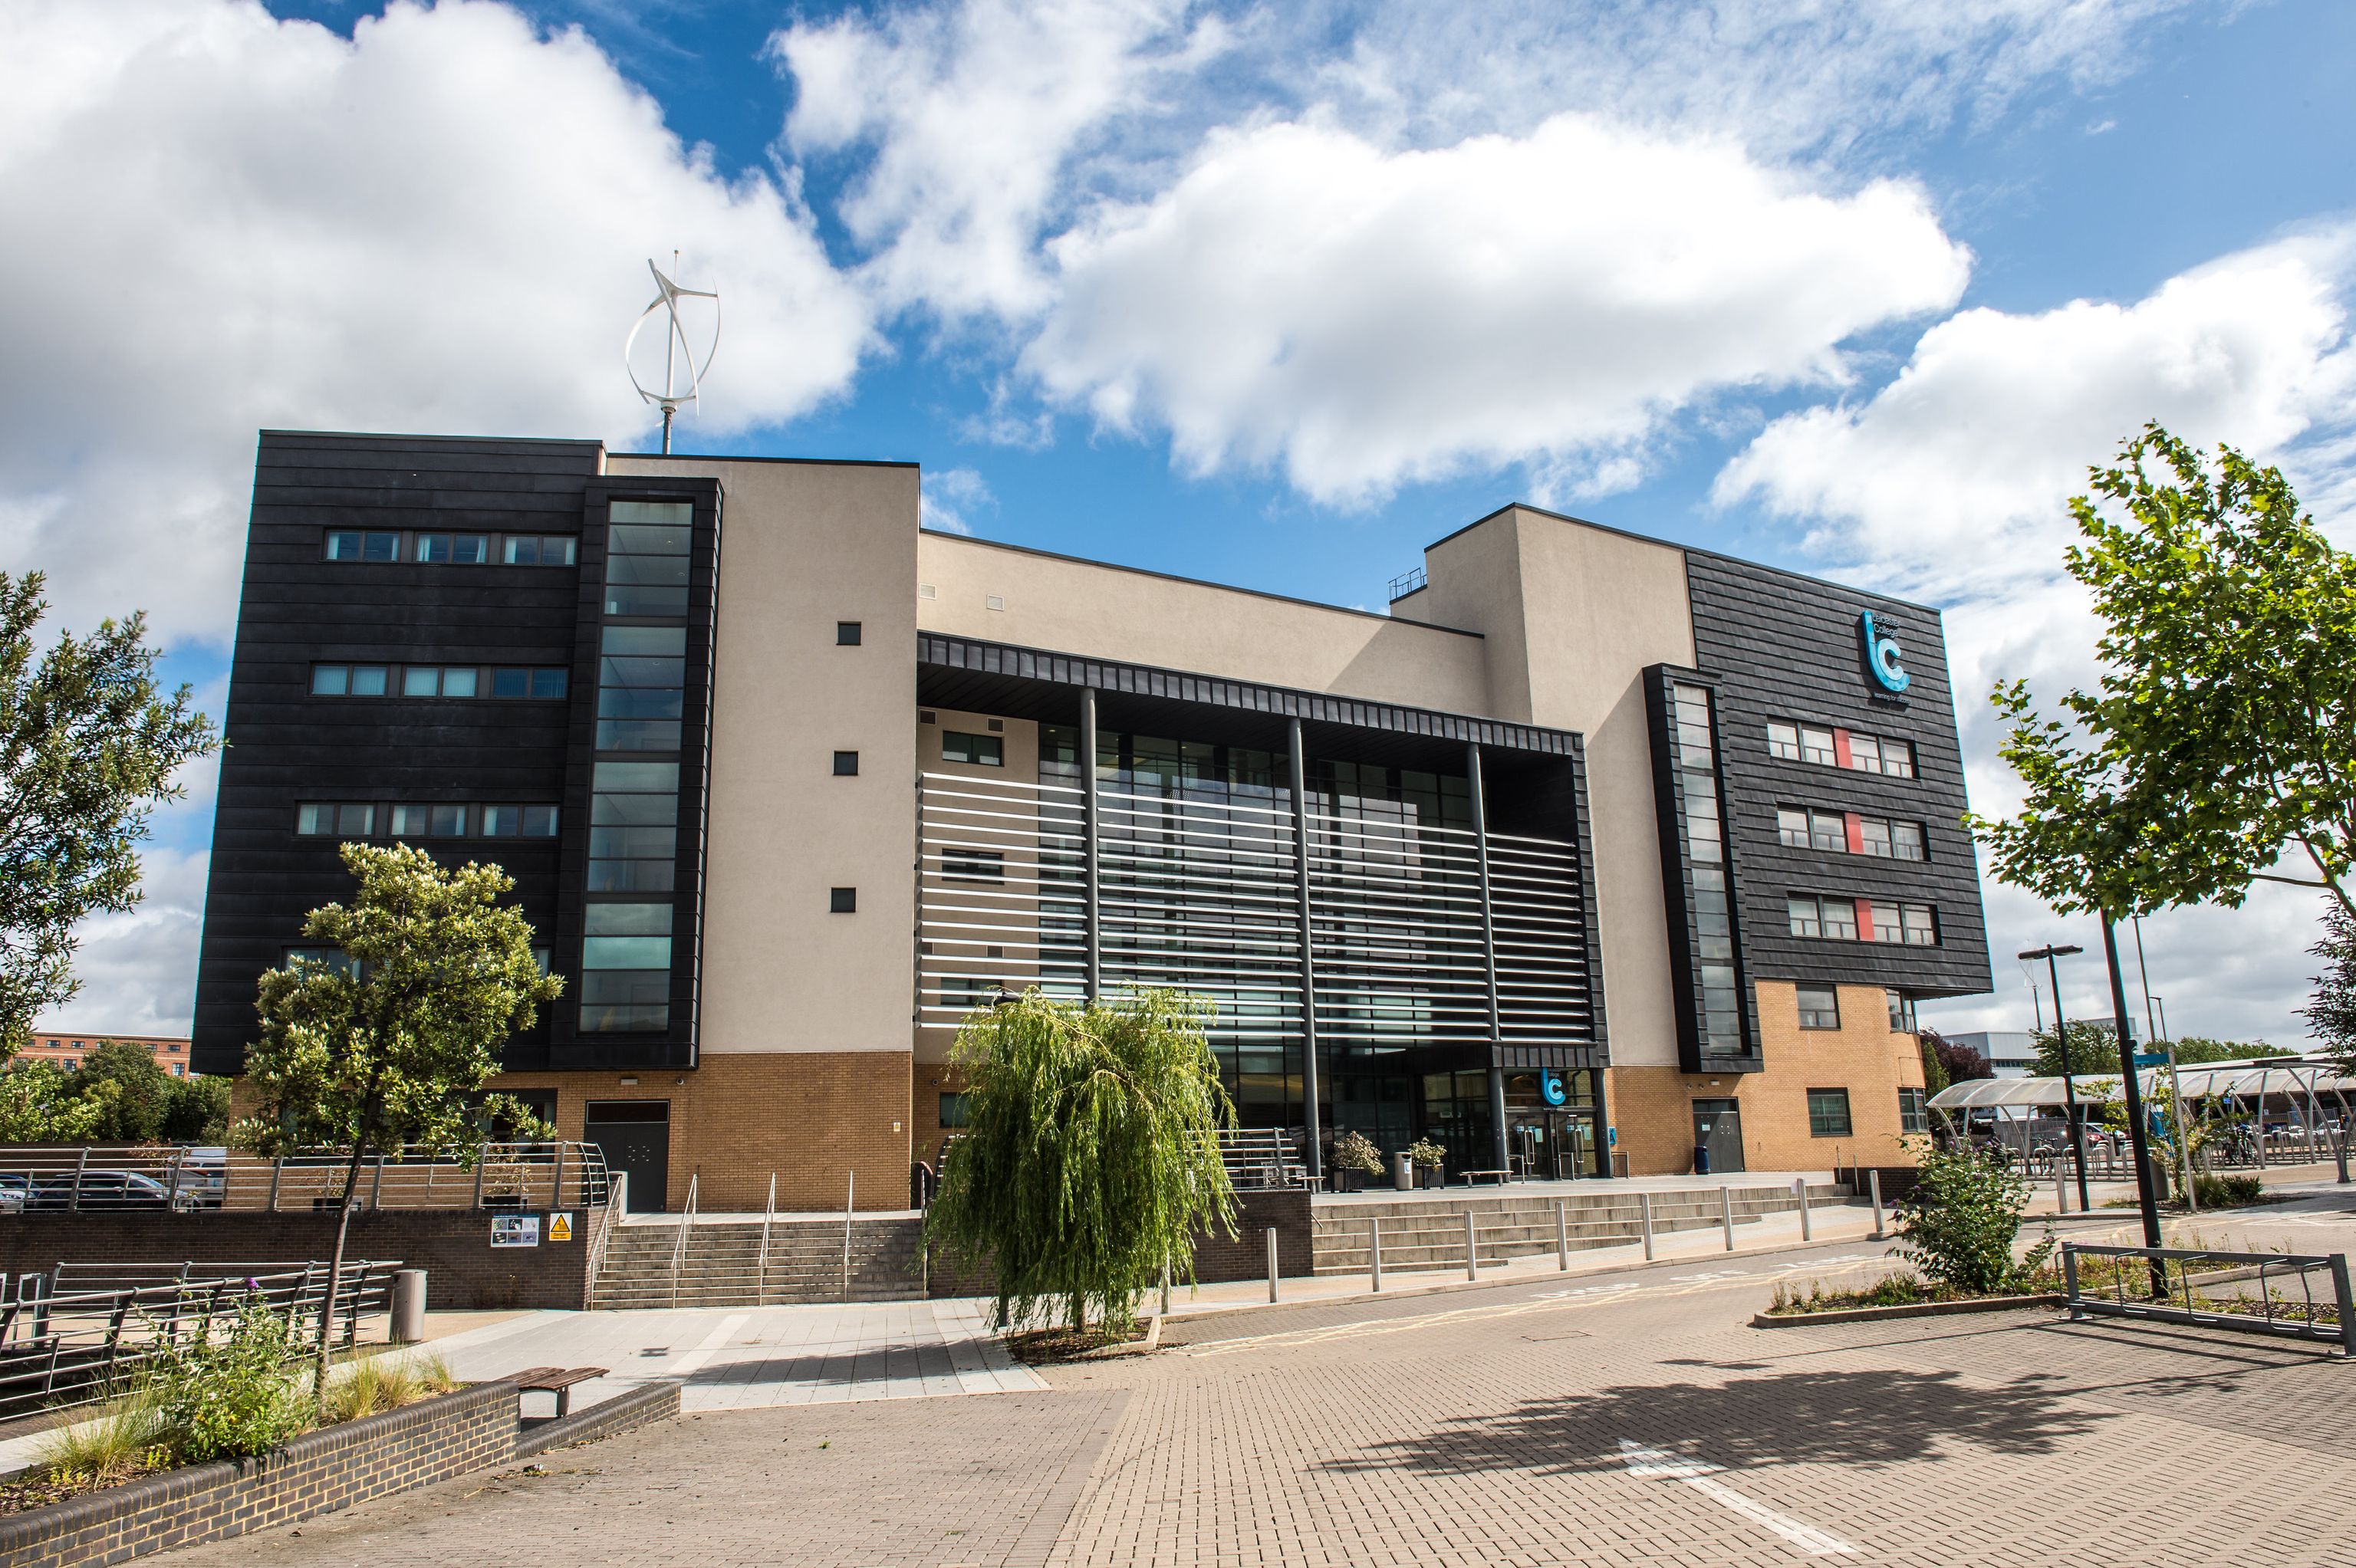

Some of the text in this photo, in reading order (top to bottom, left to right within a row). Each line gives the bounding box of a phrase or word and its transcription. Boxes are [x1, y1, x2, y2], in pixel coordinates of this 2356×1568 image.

[1873, 614, 1900, 627] Leicester
[1874, 623, 1898, 638] College
[1530, 1283, 1640, 1298] DROP
